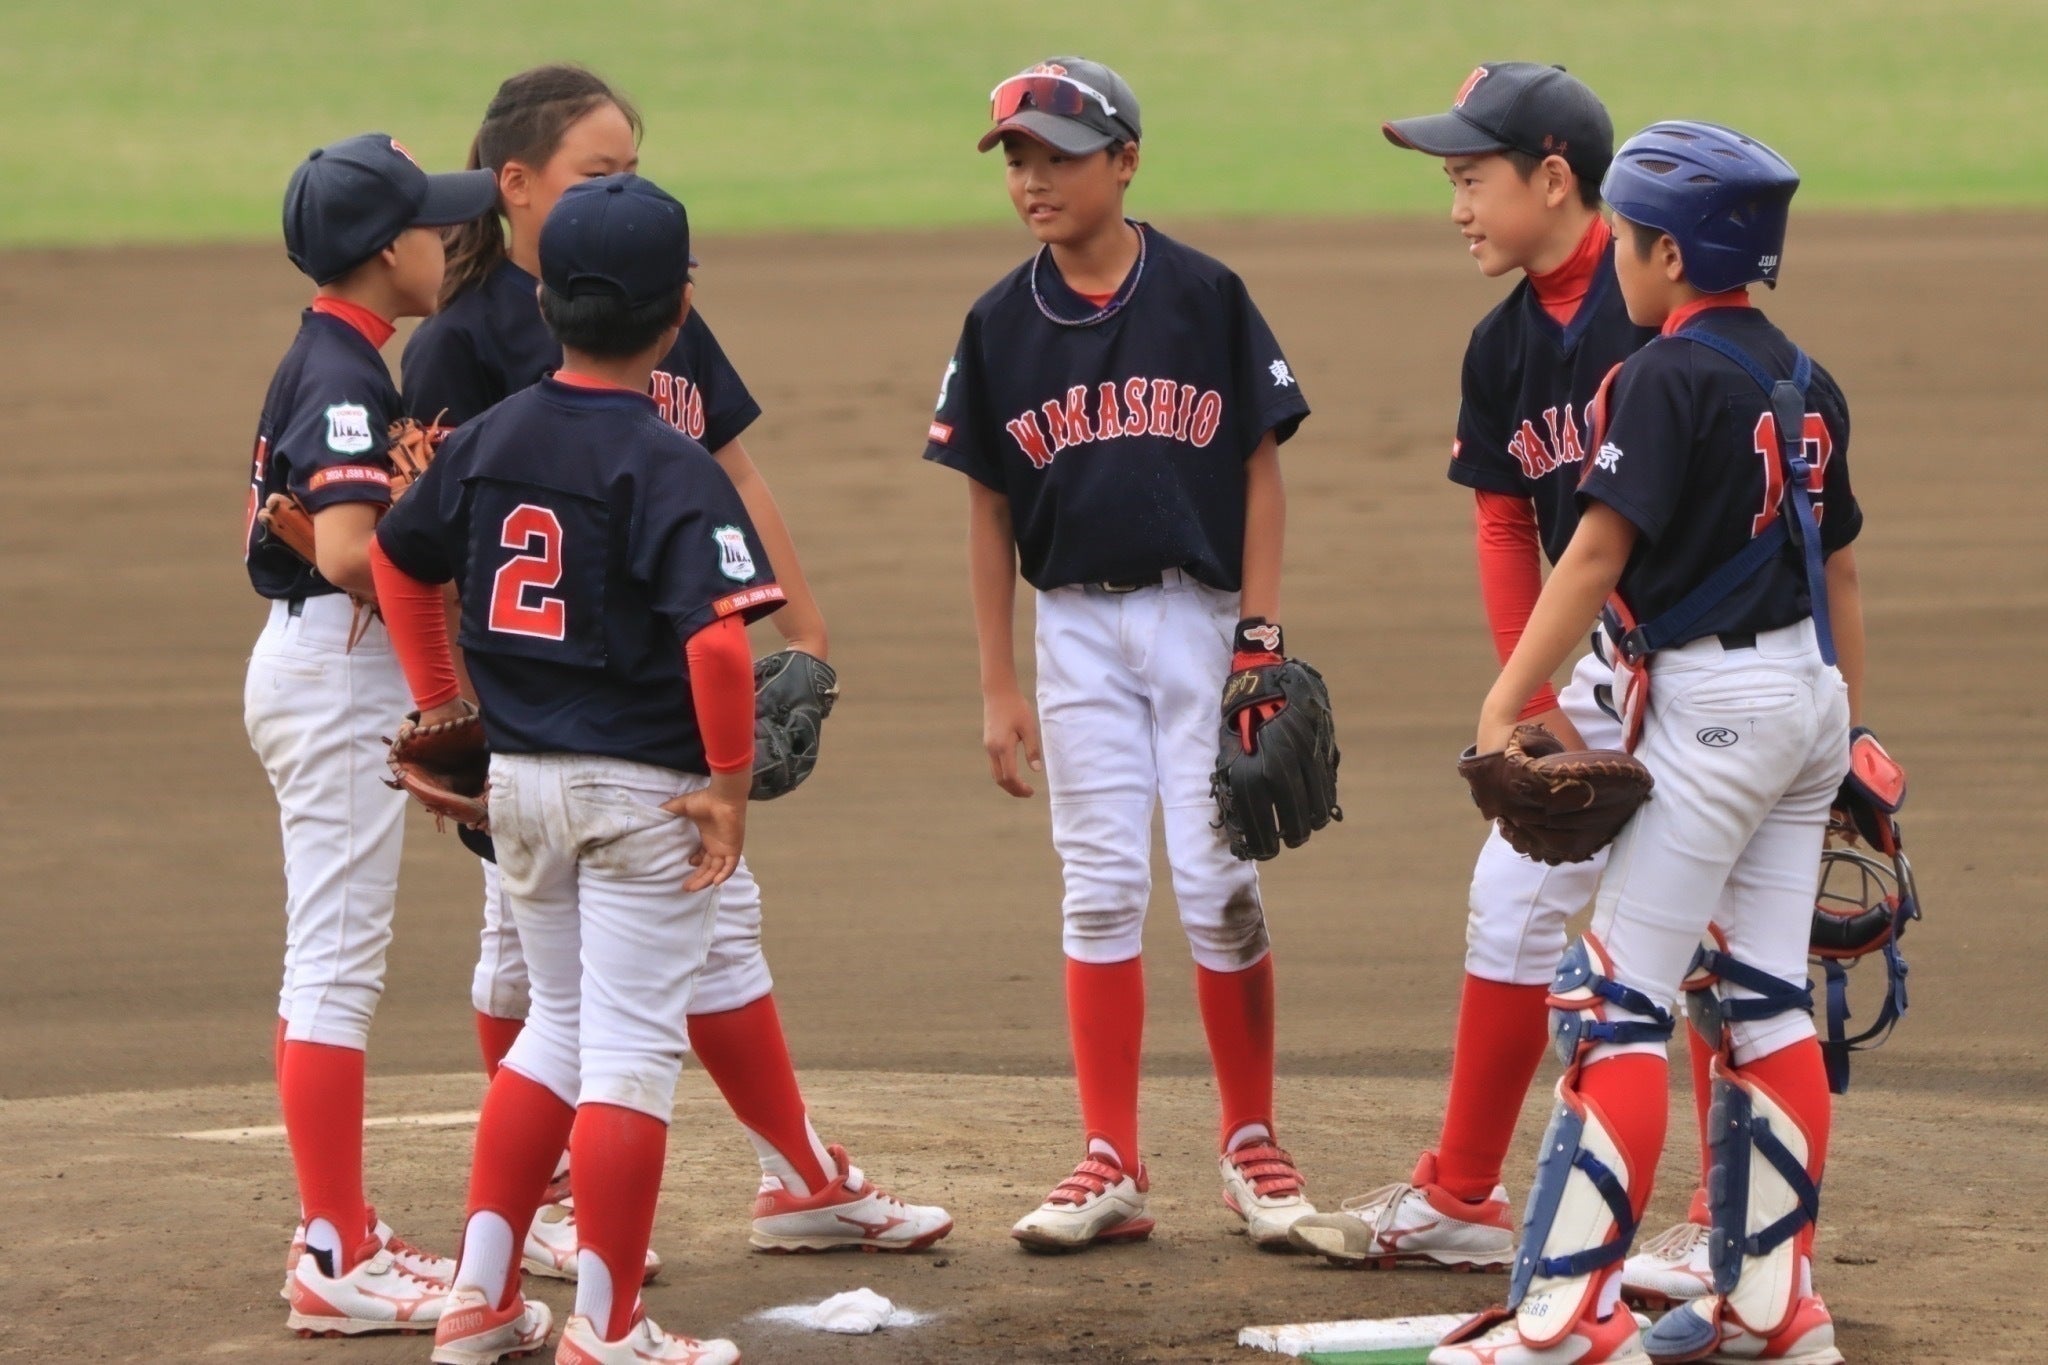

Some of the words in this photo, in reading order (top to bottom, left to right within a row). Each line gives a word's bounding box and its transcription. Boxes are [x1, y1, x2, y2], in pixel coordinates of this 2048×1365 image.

[1268, 359, 1295, 387] 東
[1006, 376, 1222, 469] WAKASHIO
[1594, 441, 1624, 474] 京
[488, 503, 565, 641] 2
